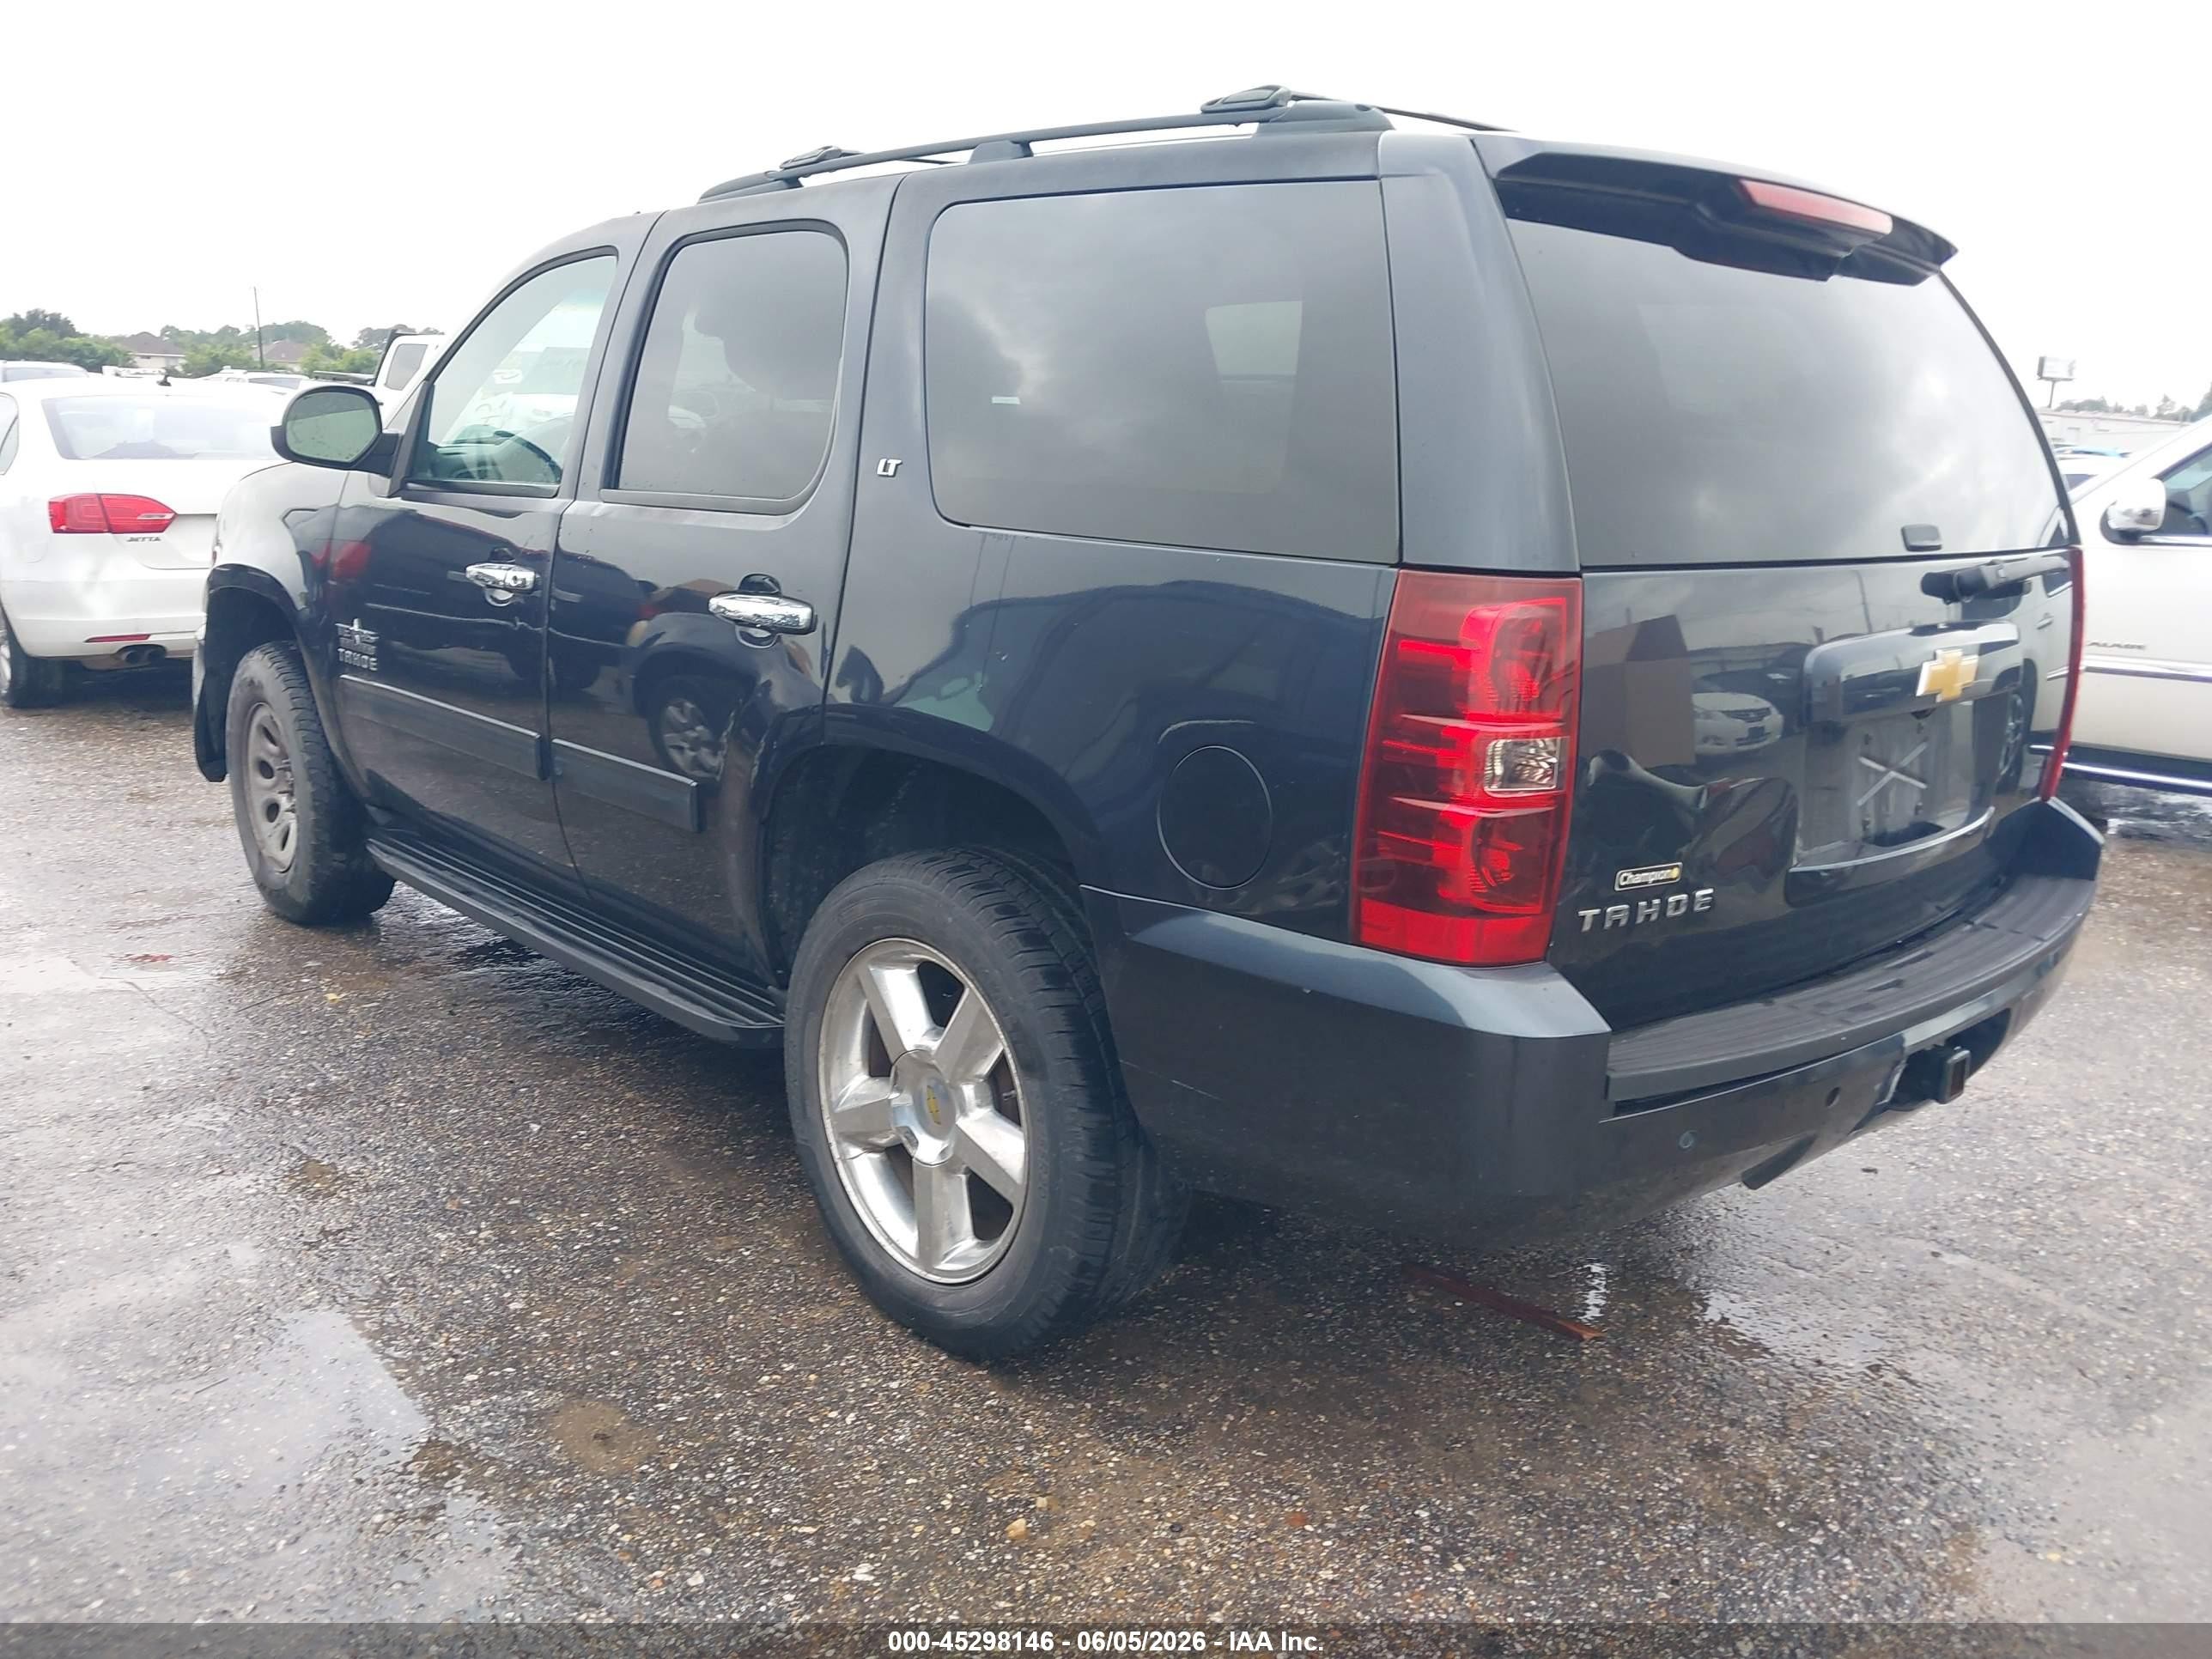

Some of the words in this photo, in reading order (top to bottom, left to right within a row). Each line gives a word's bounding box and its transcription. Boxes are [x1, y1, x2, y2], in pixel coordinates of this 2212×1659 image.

[877, 458, 902, 476] LT
[337, 647, 378, 671] TAHOE
[1577, 888, 1715, 933] TAHOE
